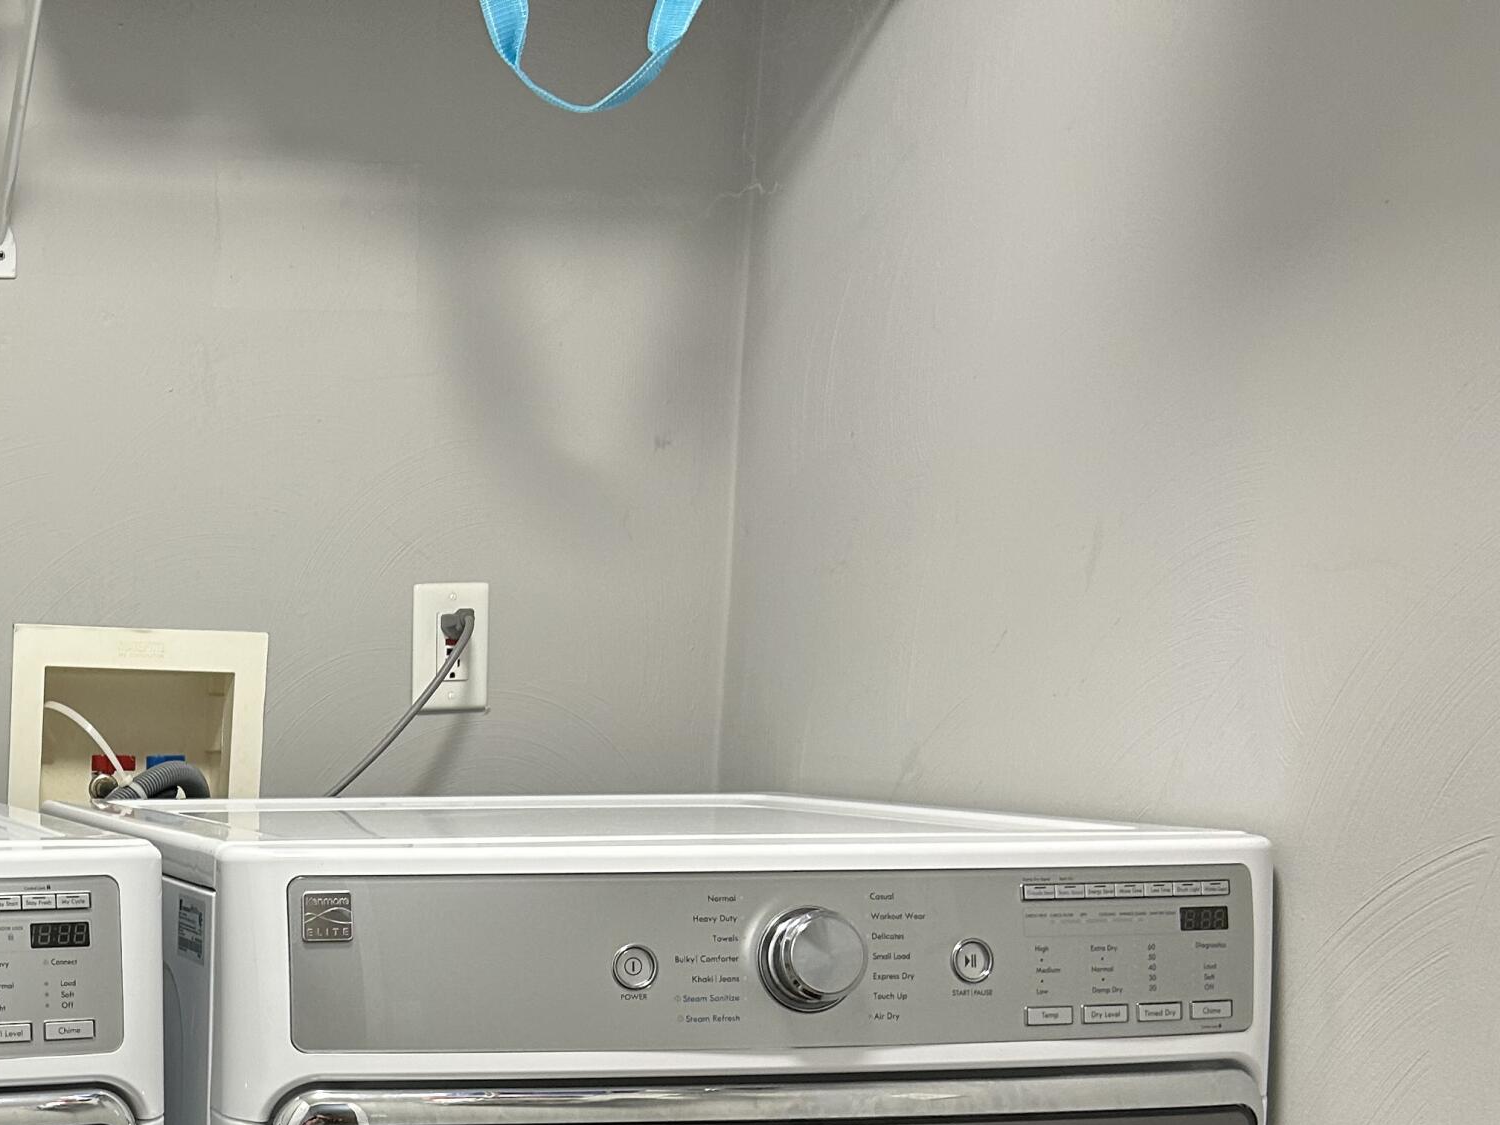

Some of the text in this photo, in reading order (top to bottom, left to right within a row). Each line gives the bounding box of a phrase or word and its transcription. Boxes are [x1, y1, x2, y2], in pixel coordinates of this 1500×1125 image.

[707, 895, 737, 903] Normal
[870, 892, 895, 900] Casual
[693, 914, 738, 924] Heavy Duty
[870, 912, 926, 920] Workout Wear
[307, 927, 349, 937] ELITE
[872, 952, 911, 960] Small Load
[50, 958, 78, 966] Connect
[901, 971, 915, 981] Dry
[60, 979, 77, 987] Loud
[620, 993, 648, 1001] POWER
[873, 992, 908, 1000] Touch Up
[61, 1001, 74, 1009] Off
[712, 1014, 741, 1023] Refresh
[873, 1011, 900, 1021] Air Dry
[4, 1029, 24, 1038] Level
[58, 1027, 81, 1035] Chime
